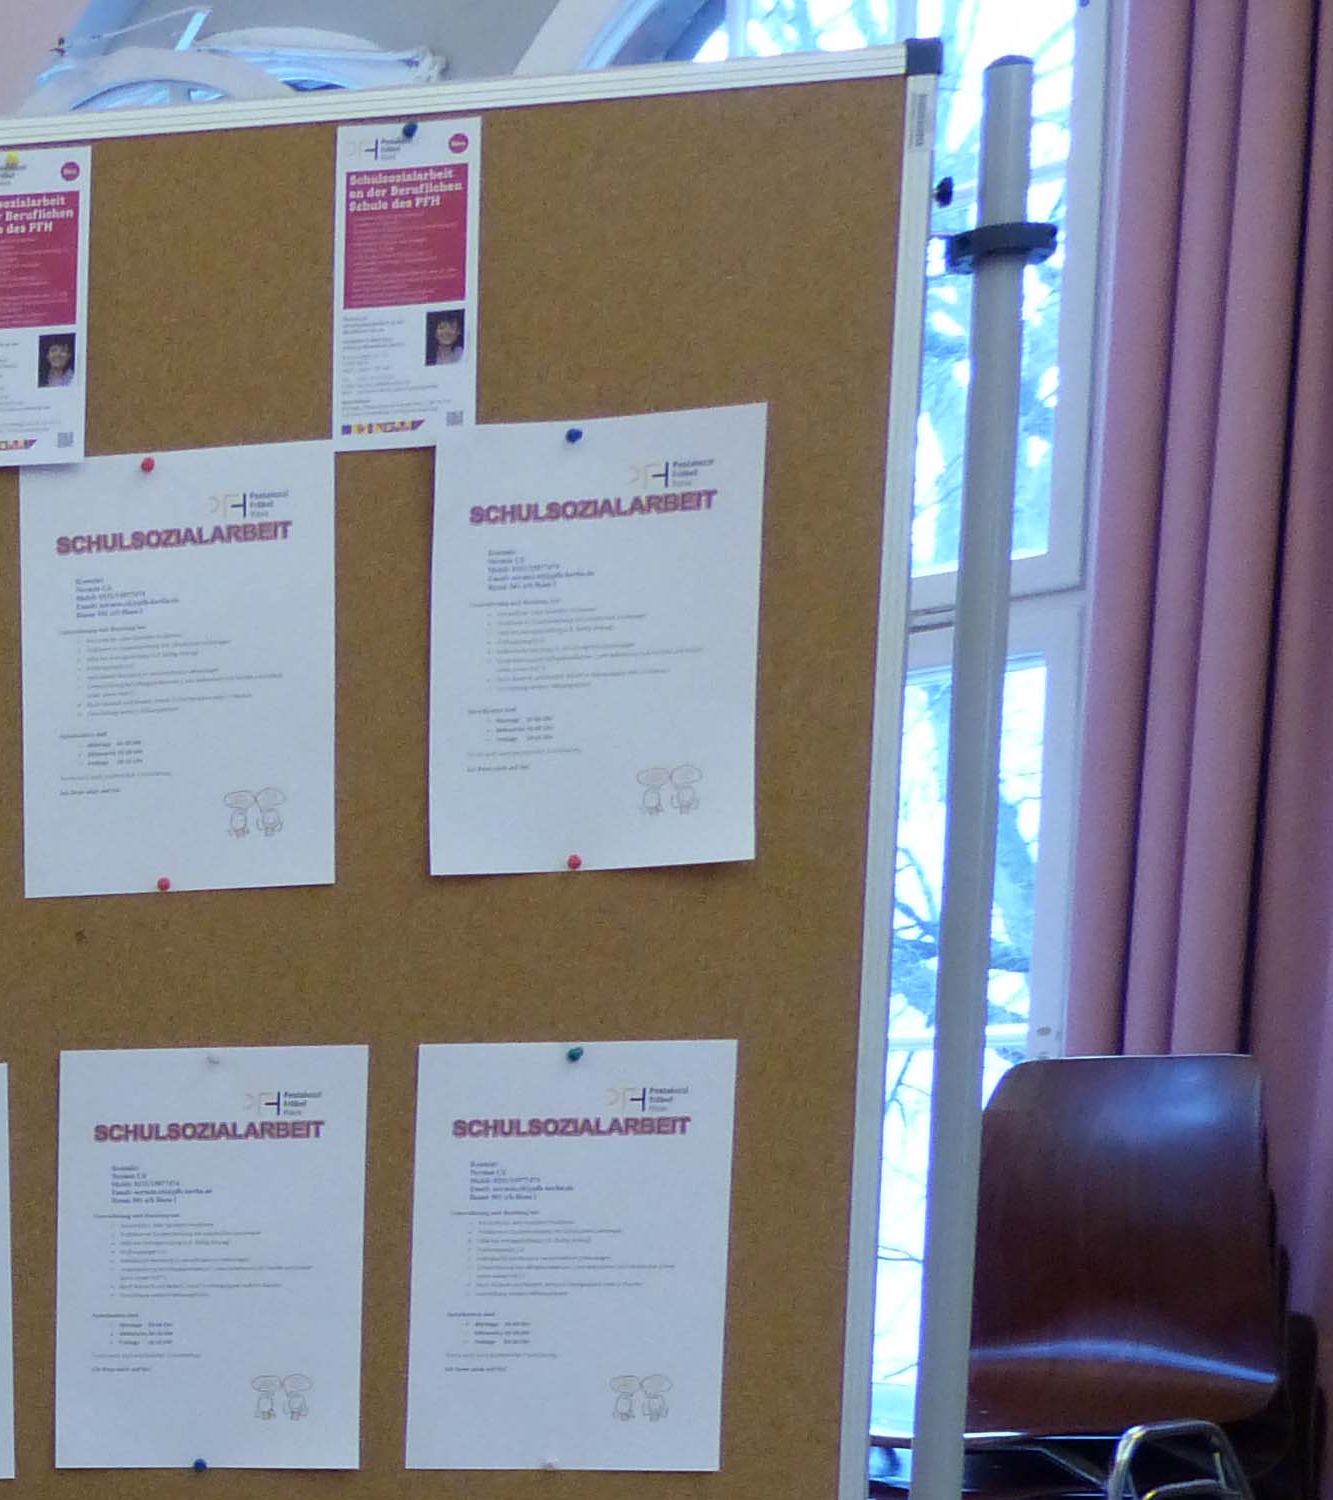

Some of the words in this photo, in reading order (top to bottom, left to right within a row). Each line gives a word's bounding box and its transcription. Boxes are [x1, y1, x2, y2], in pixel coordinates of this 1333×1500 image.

[469, 490, 718, 526] SCHULSOZIALARBEIT
[56, 520, 292, 557] SCHULSOZIALARBEIT
[94, 1120, 325, 1143] SCHULSOZIALARBEIT
[452, 1117, 692, 1138] SCHULSOZIALARBEIT
